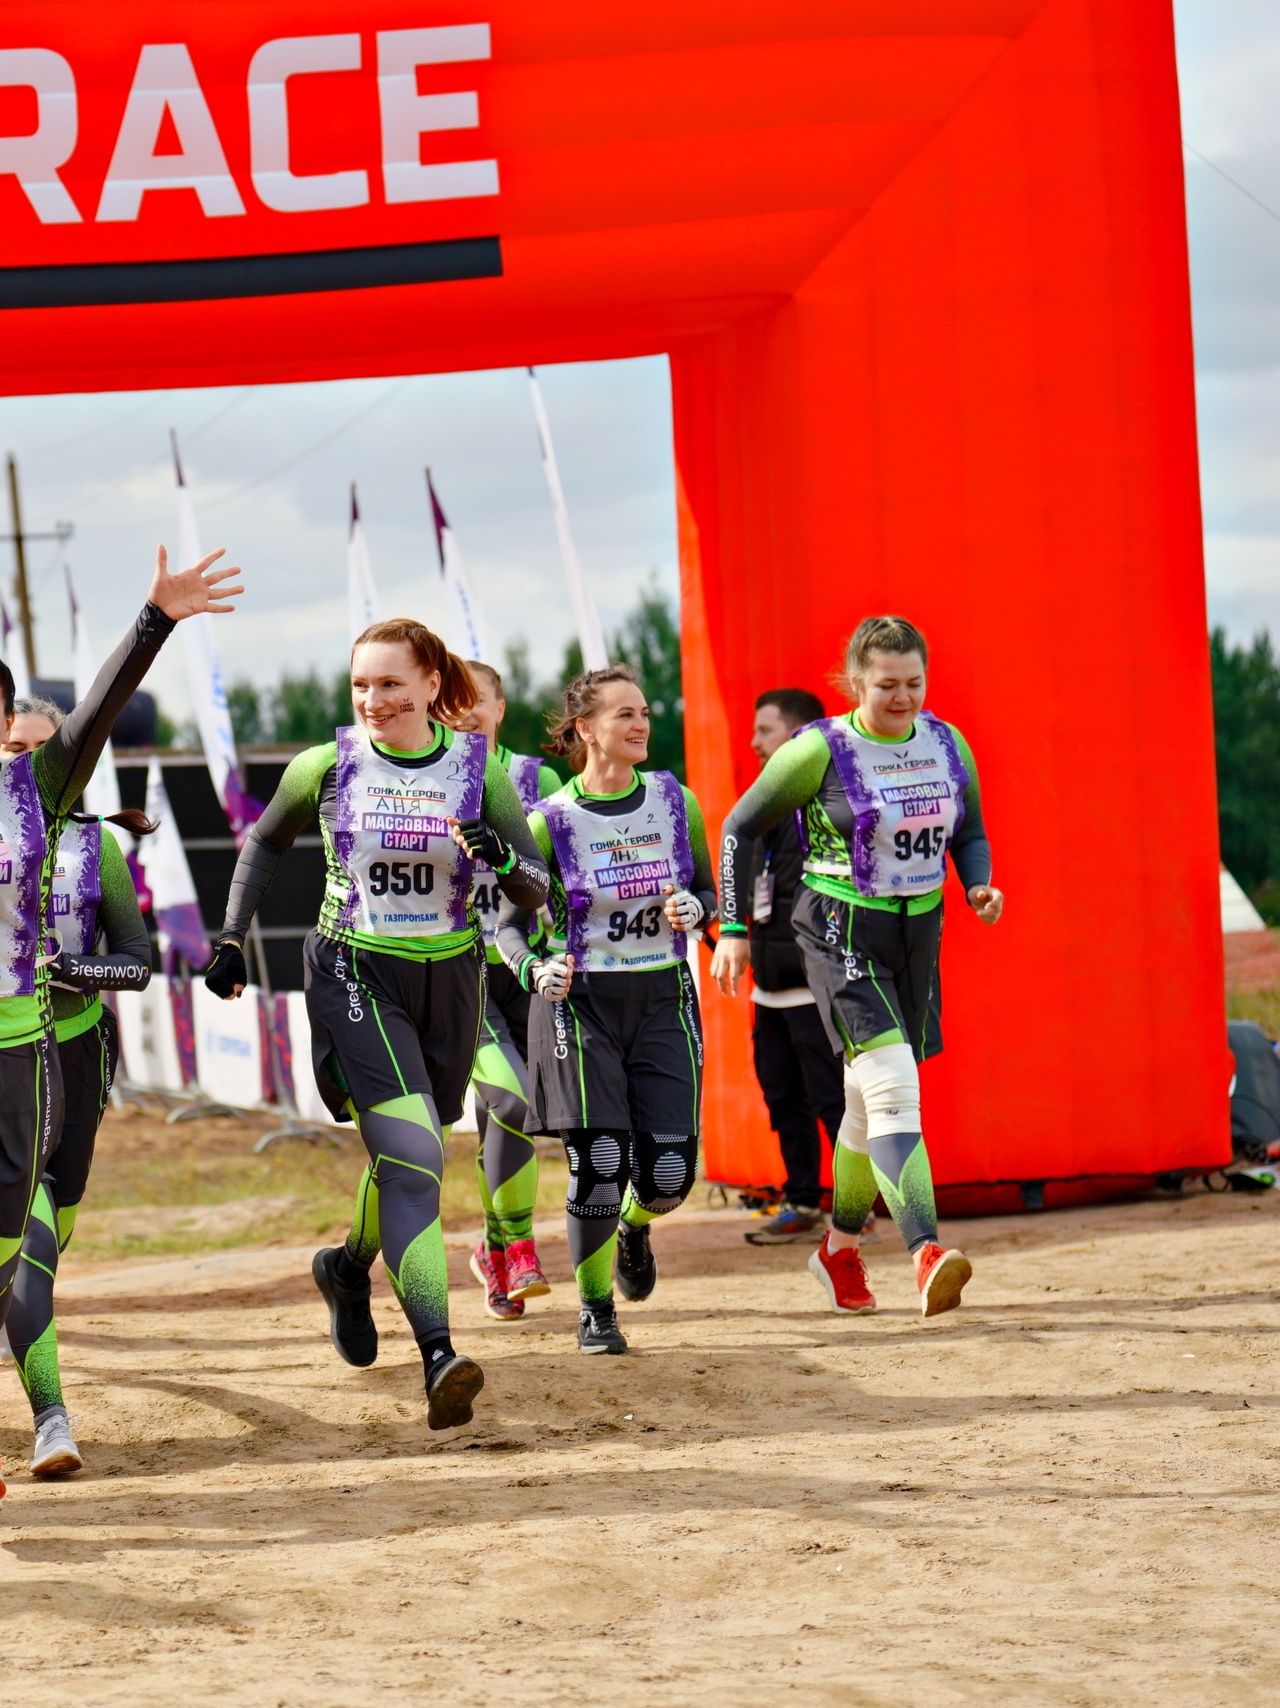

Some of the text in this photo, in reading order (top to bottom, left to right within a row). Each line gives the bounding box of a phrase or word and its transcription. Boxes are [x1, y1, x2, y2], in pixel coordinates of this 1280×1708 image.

[873, 758, 937, 773] ГОНКА ГЕРОЕВ
[367, 786, 447, 800] ГОНКА ГЕРОЕВ
[883, 781, 948, 803] МАССОВЫЙ
[376, 797, 422, 815] АНЯ
[905, 799, 938, 815] СТАРТ
[365, 815, 445, 834] МАССОВЫЙ
[646, 813, 658, 824] 2
[384, 833, 425, 851] СТАРТ
[589, 832, 662, 852] ГОНКА ГЕРОЕВ
[894, 826, 945, 861] 945
[608, 849, 640, 867] АНЯ
[369, 862, 435, 897] 950
[598, 859, 669, 885] МАССОВЫЙ
[723, 834, 738, 921] Greenway
[620, 880, 657, 899] СТАРТ
[383, 912, 439, 923] ГАЗПРОМБАНК
[607, 906, 662, 943] 943
[621, 953, 667, 966] ГАЗПРОМБАНК
[71, 959, 144, 982] Greenway
[334, 957, 364, 1022] Greeay
[554, 1000, 569, 1060] Greenw
